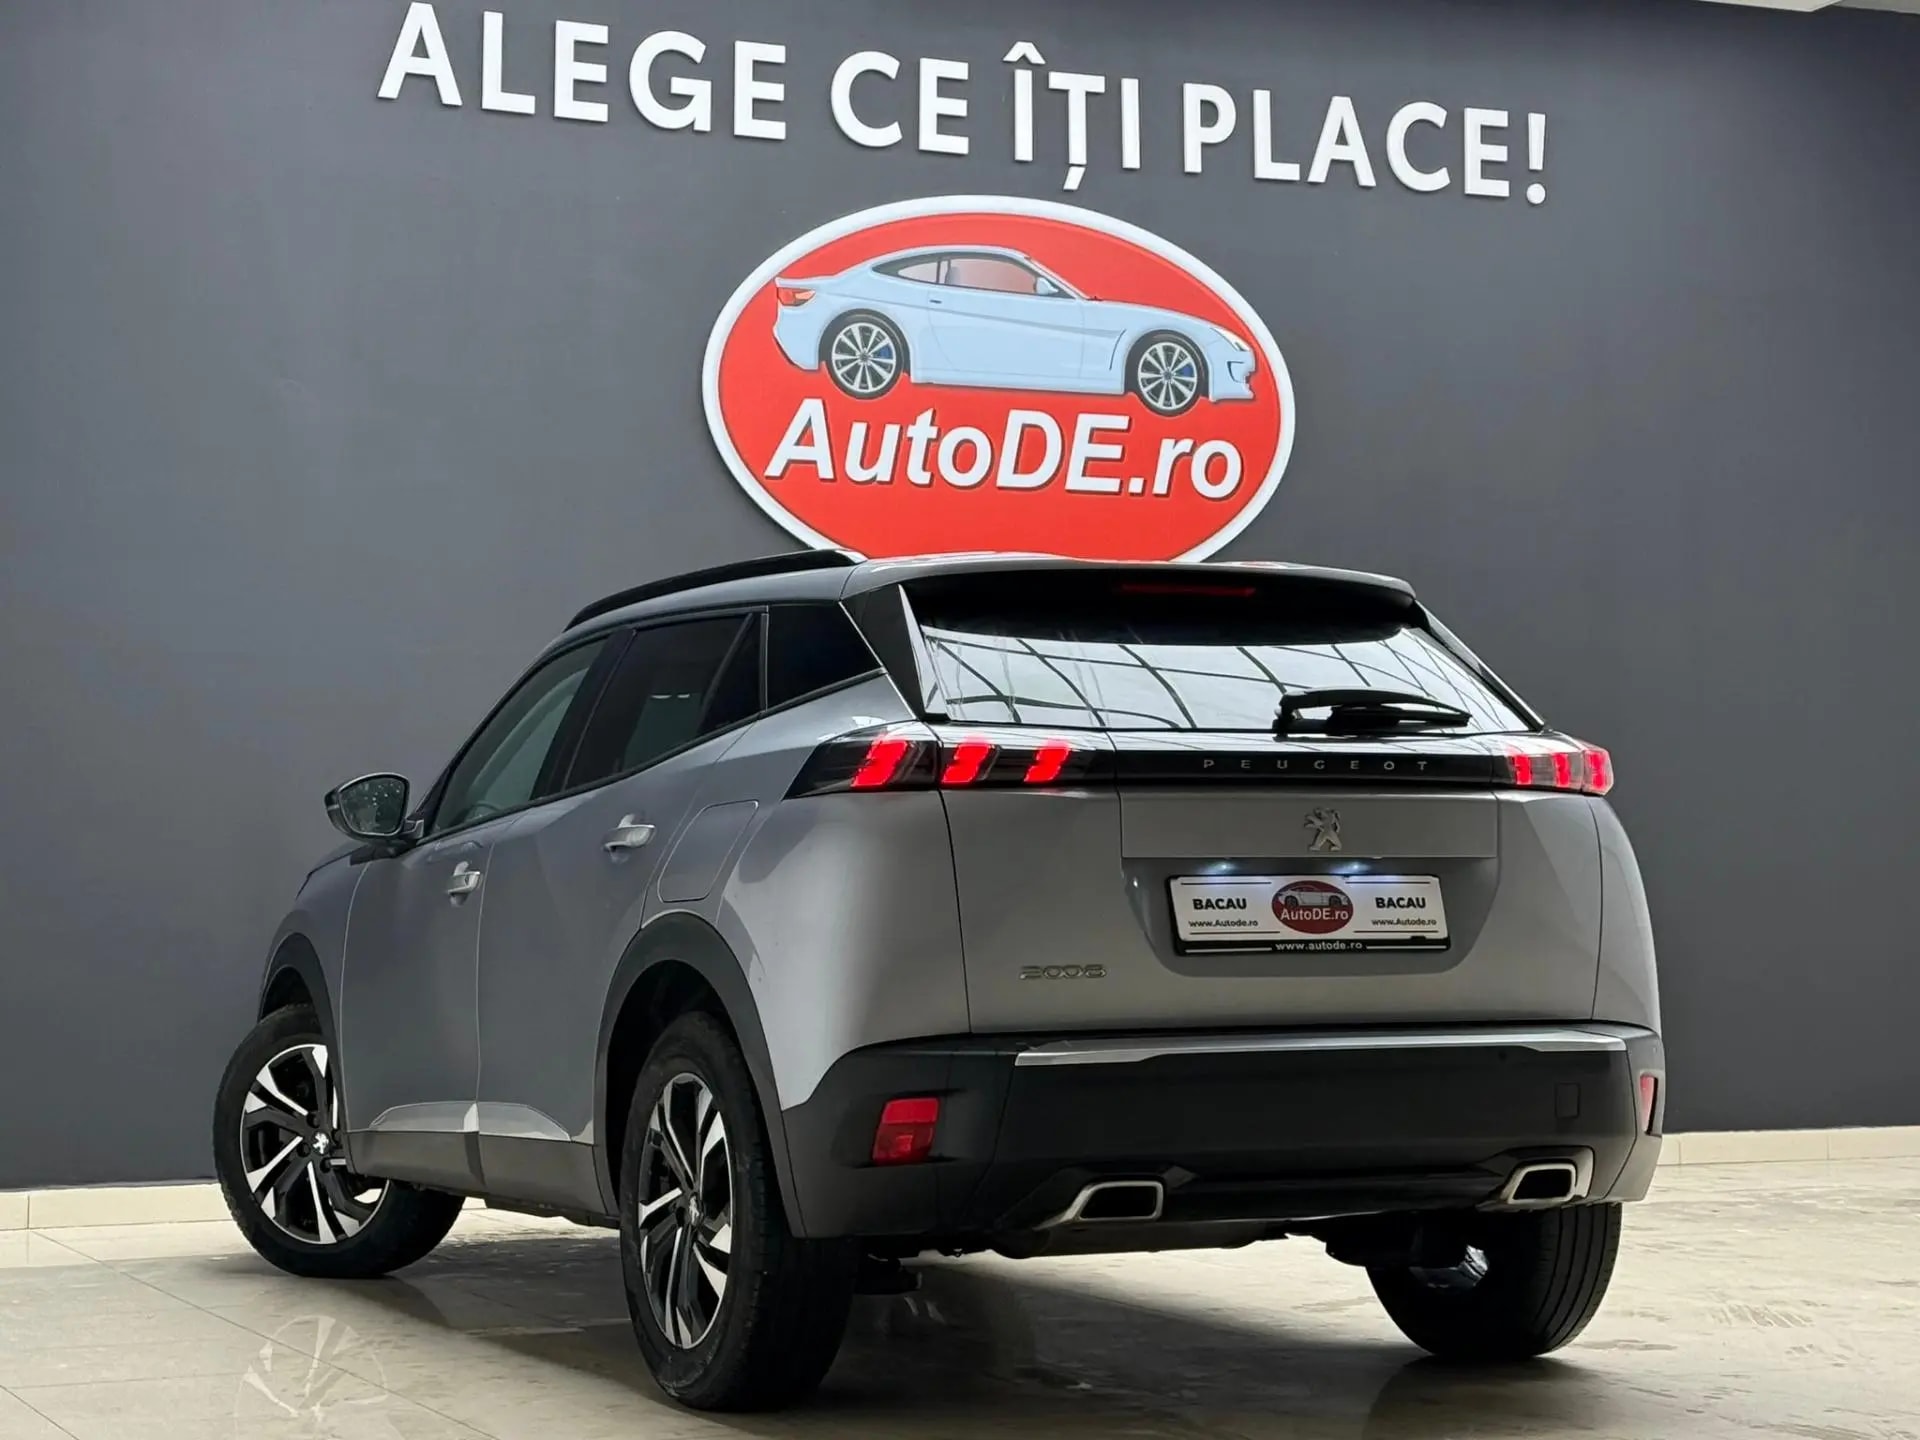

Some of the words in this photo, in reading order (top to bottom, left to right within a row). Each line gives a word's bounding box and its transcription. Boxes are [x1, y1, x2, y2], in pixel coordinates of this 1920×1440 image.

[378, 1, 787, 141] ALEGE
[830, 50, 970, 155] CE
[1003, 41, 1141, 191] ÎȚI
[1183, 83, 1547, 205] PLACE!
[764, 397, 1243, 500] AutoDE.ro
[1203, 759, 1427, 771] PEUGEOT
[1193, 898, 1247, 910] BACAU
[1375, 897, 1426, 909] BACAU
[1280, 907, 1349, 921] AutoDE.ro
[1188, 919, 1259, 928] www.Autode.ro
[1275, 941, 1363, 951] www.autode.ro
[1020, 965, 1106, 979] 2008
